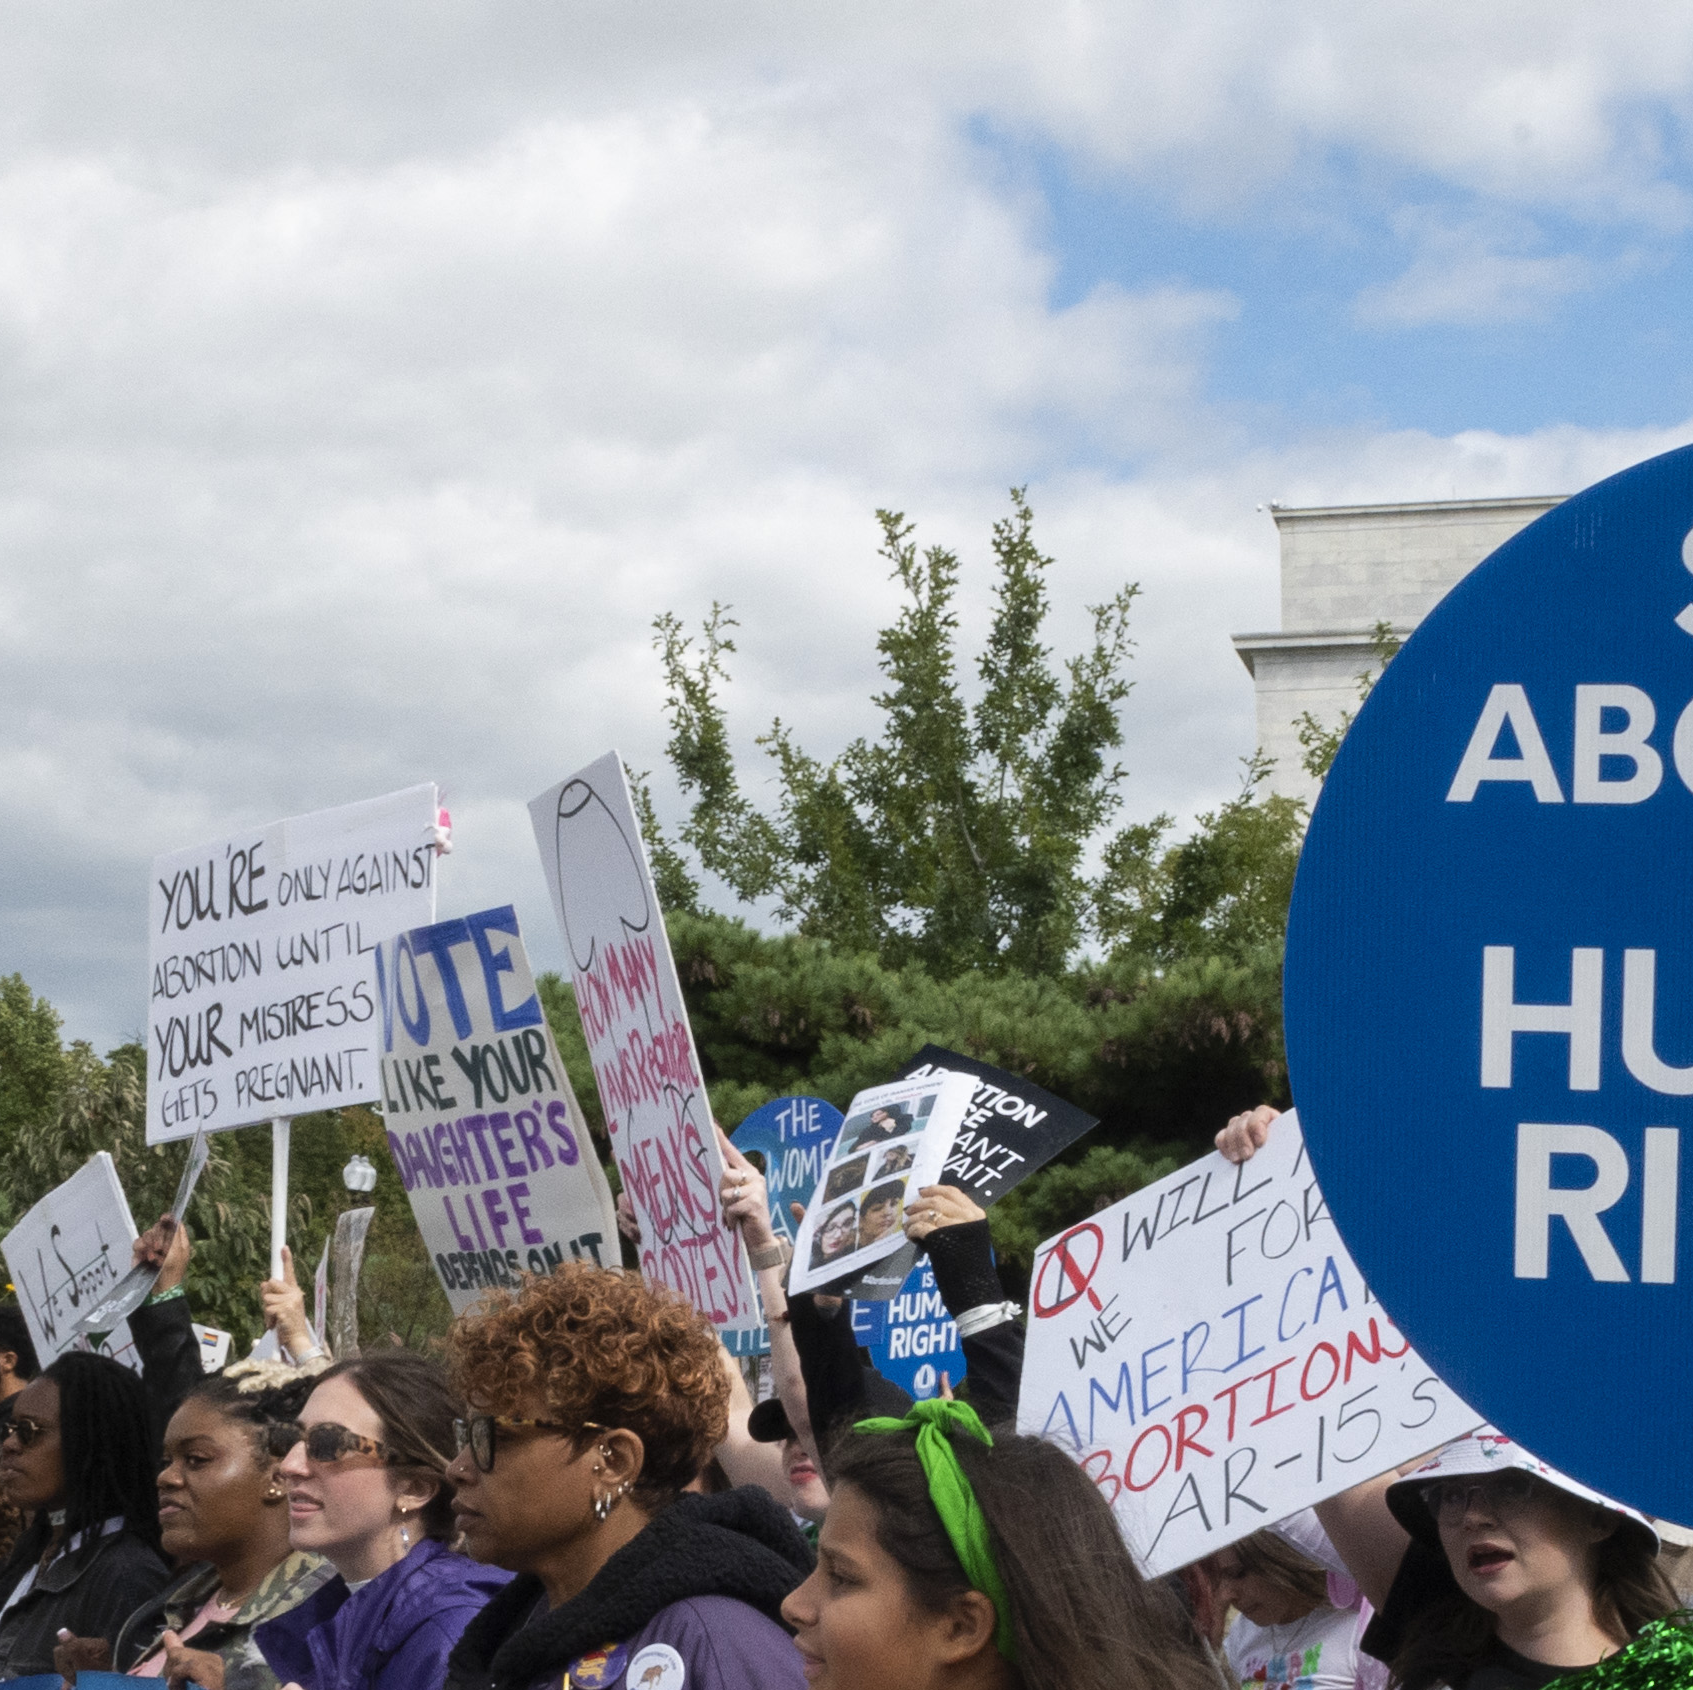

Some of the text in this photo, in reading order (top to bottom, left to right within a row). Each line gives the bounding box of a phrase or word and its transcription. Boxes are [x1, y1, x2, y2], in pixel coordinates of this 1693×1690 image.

[158, 841, 437, 935] YOU'RE ONLY AGAINST
[152, 921, 376, 1004] ABORTION UNTIL
[374, 904, 543, 1053] VOTE
[604, 934, 667, 1023] MANY
[154, 980, 374, 1082] YOUR MISTRESS
[381, 1028, 558, 1115] LIKE YOUR
[161, 1048, 368, 1128] GETS PREGNANT.
[775, 1099, 822, 1145] THE
[387, 1098, 579, 1193] DAUGHTER'S
[954, 1130, 1026, 1172] AN'T
[442, 1182, 544, 1253] LIFE
[1122, 1160, 1273, 1263] WILL
[1069, 1294, 1133, 1370] WE
